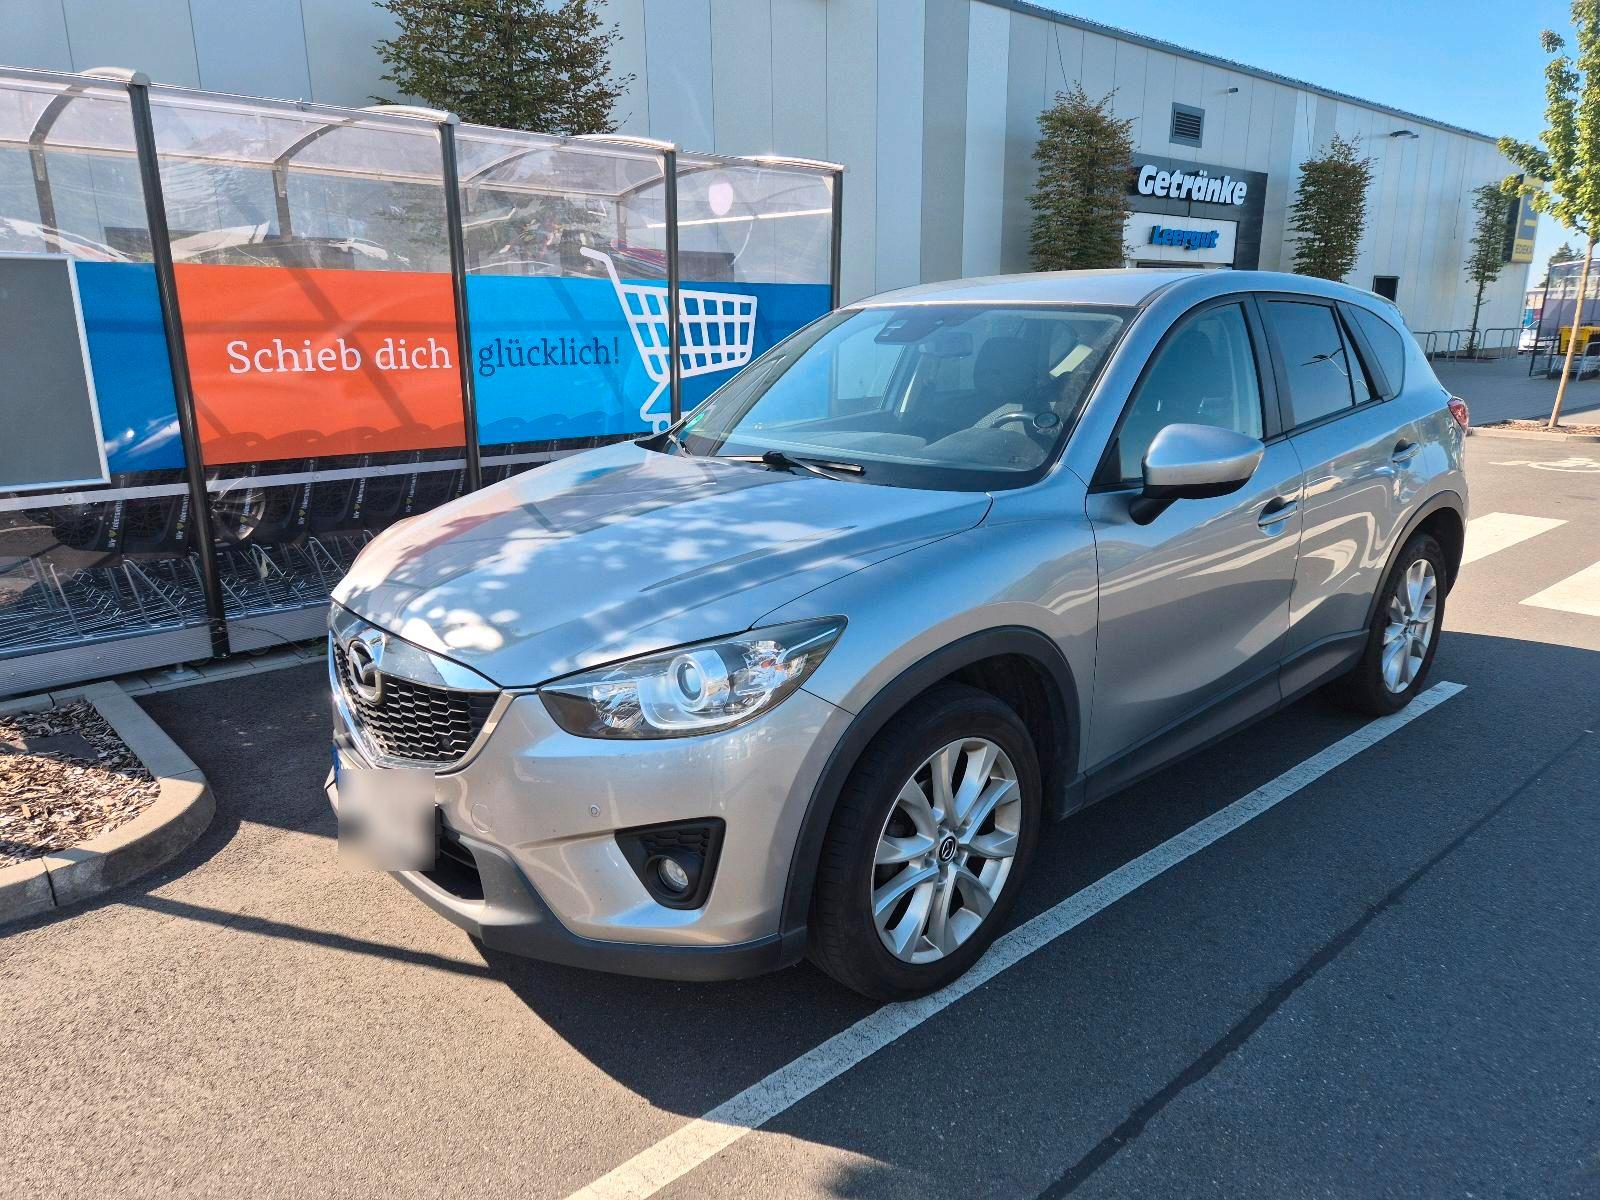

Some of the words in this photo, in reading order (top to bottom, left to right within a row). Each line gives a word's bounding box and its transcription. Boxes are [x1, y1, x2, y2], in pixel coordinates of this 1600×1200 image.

[1138, 164, 1248, 206] Getränke
[1150, 225, 1220, 251] Leergut
[226, 337, 361, 374] Schieb
[375, 337, 453, 370] dich
[478, 336, 619, 377] glücklich!
